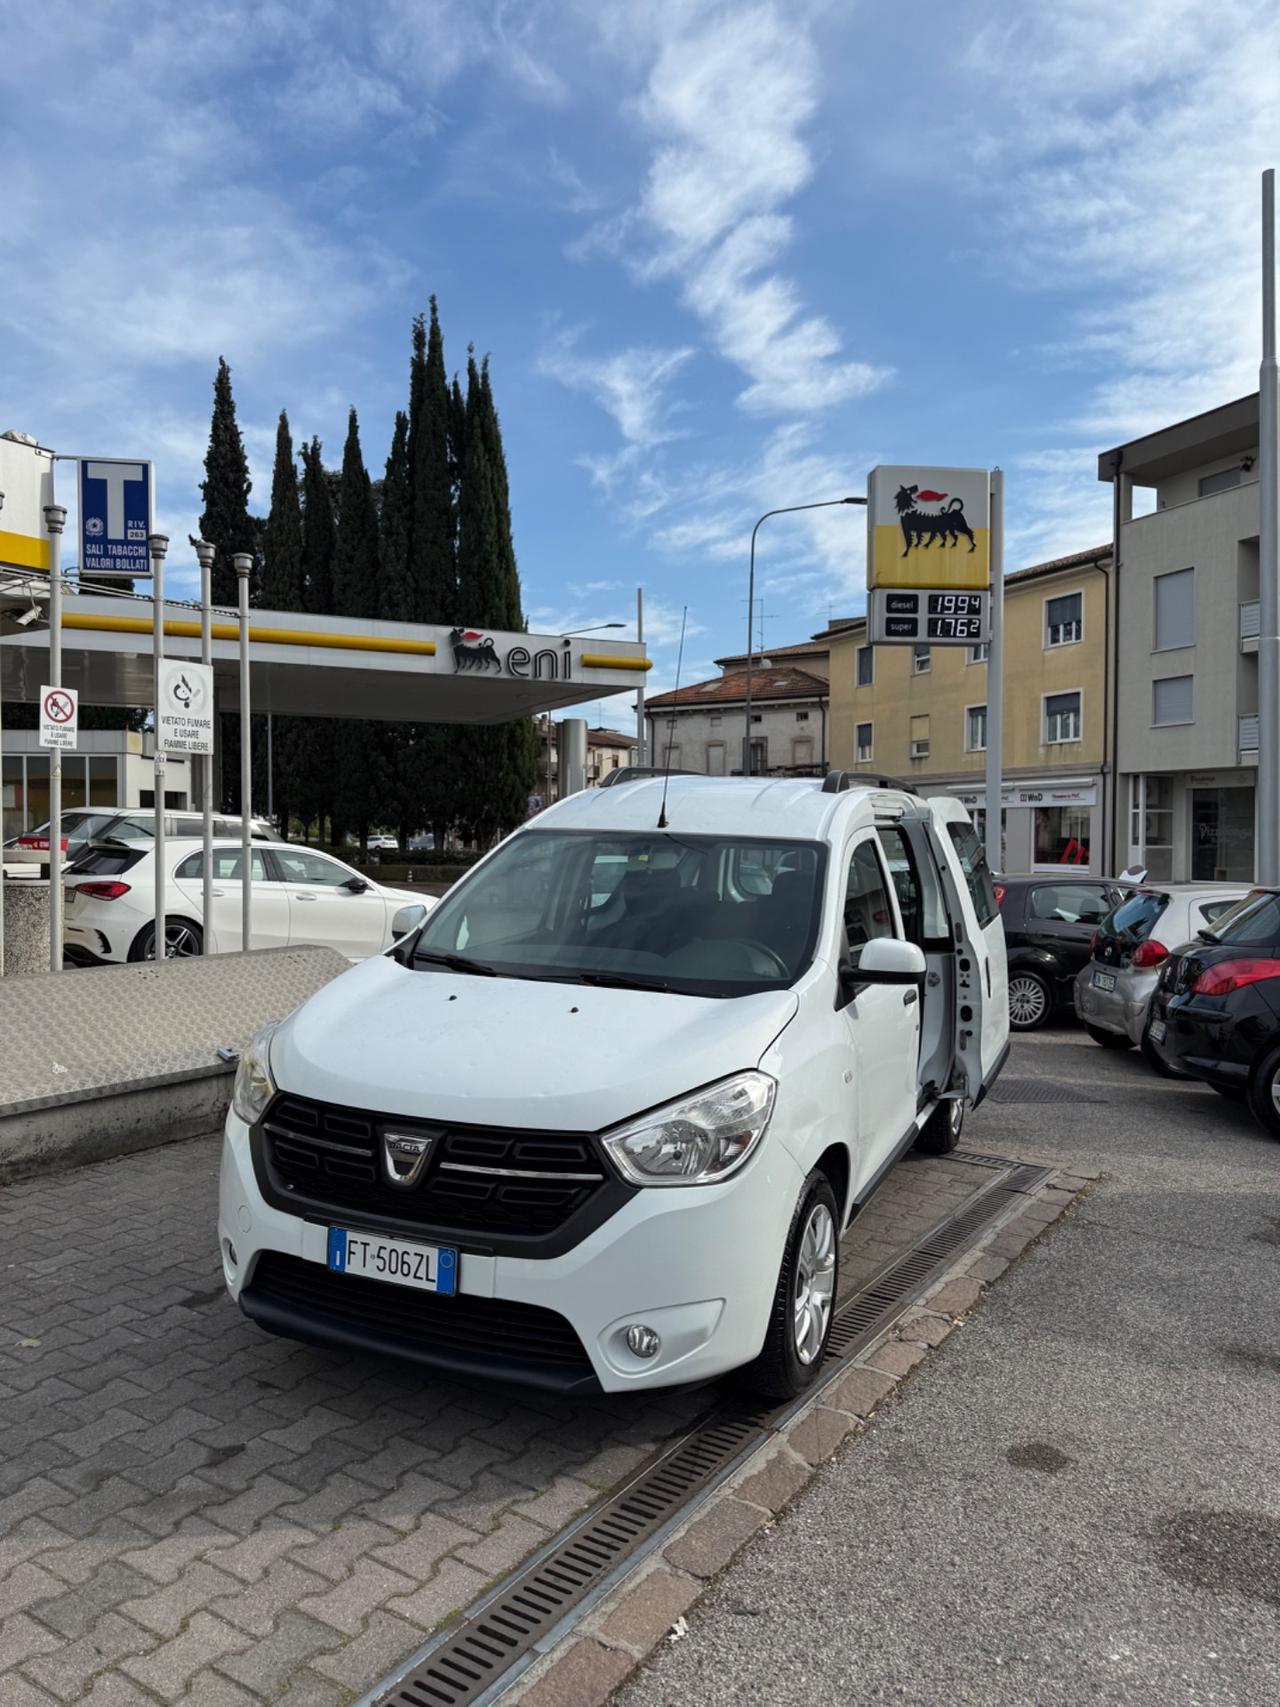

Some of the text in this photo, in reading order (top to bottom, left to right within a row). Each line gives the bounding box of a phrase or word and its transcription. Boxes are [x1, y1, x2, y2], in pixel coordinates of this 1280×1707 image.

[87, 462, 143, 540] T
[127, 520, 146, 529] RIV.
[86, 543, 146, 556] SALI TABACCHI
[85, 557, 147, 570] VALORI BOLLATI
[890, 600, 913, 609] diesel
[890, 622, 912, 632] super
[507, 638, 572, 680] eni
[161, 716, 211, 729] VIETATO FUMARE
[173, 728, 199, 739] E USARE
[164, 738, 209, 751] FIAMME LIBERE
[389, 1141, 421, 1153] DACIA
[347, 1239, 370, 1268] FT
[376, 1245, 436, 1283] 506ZL
